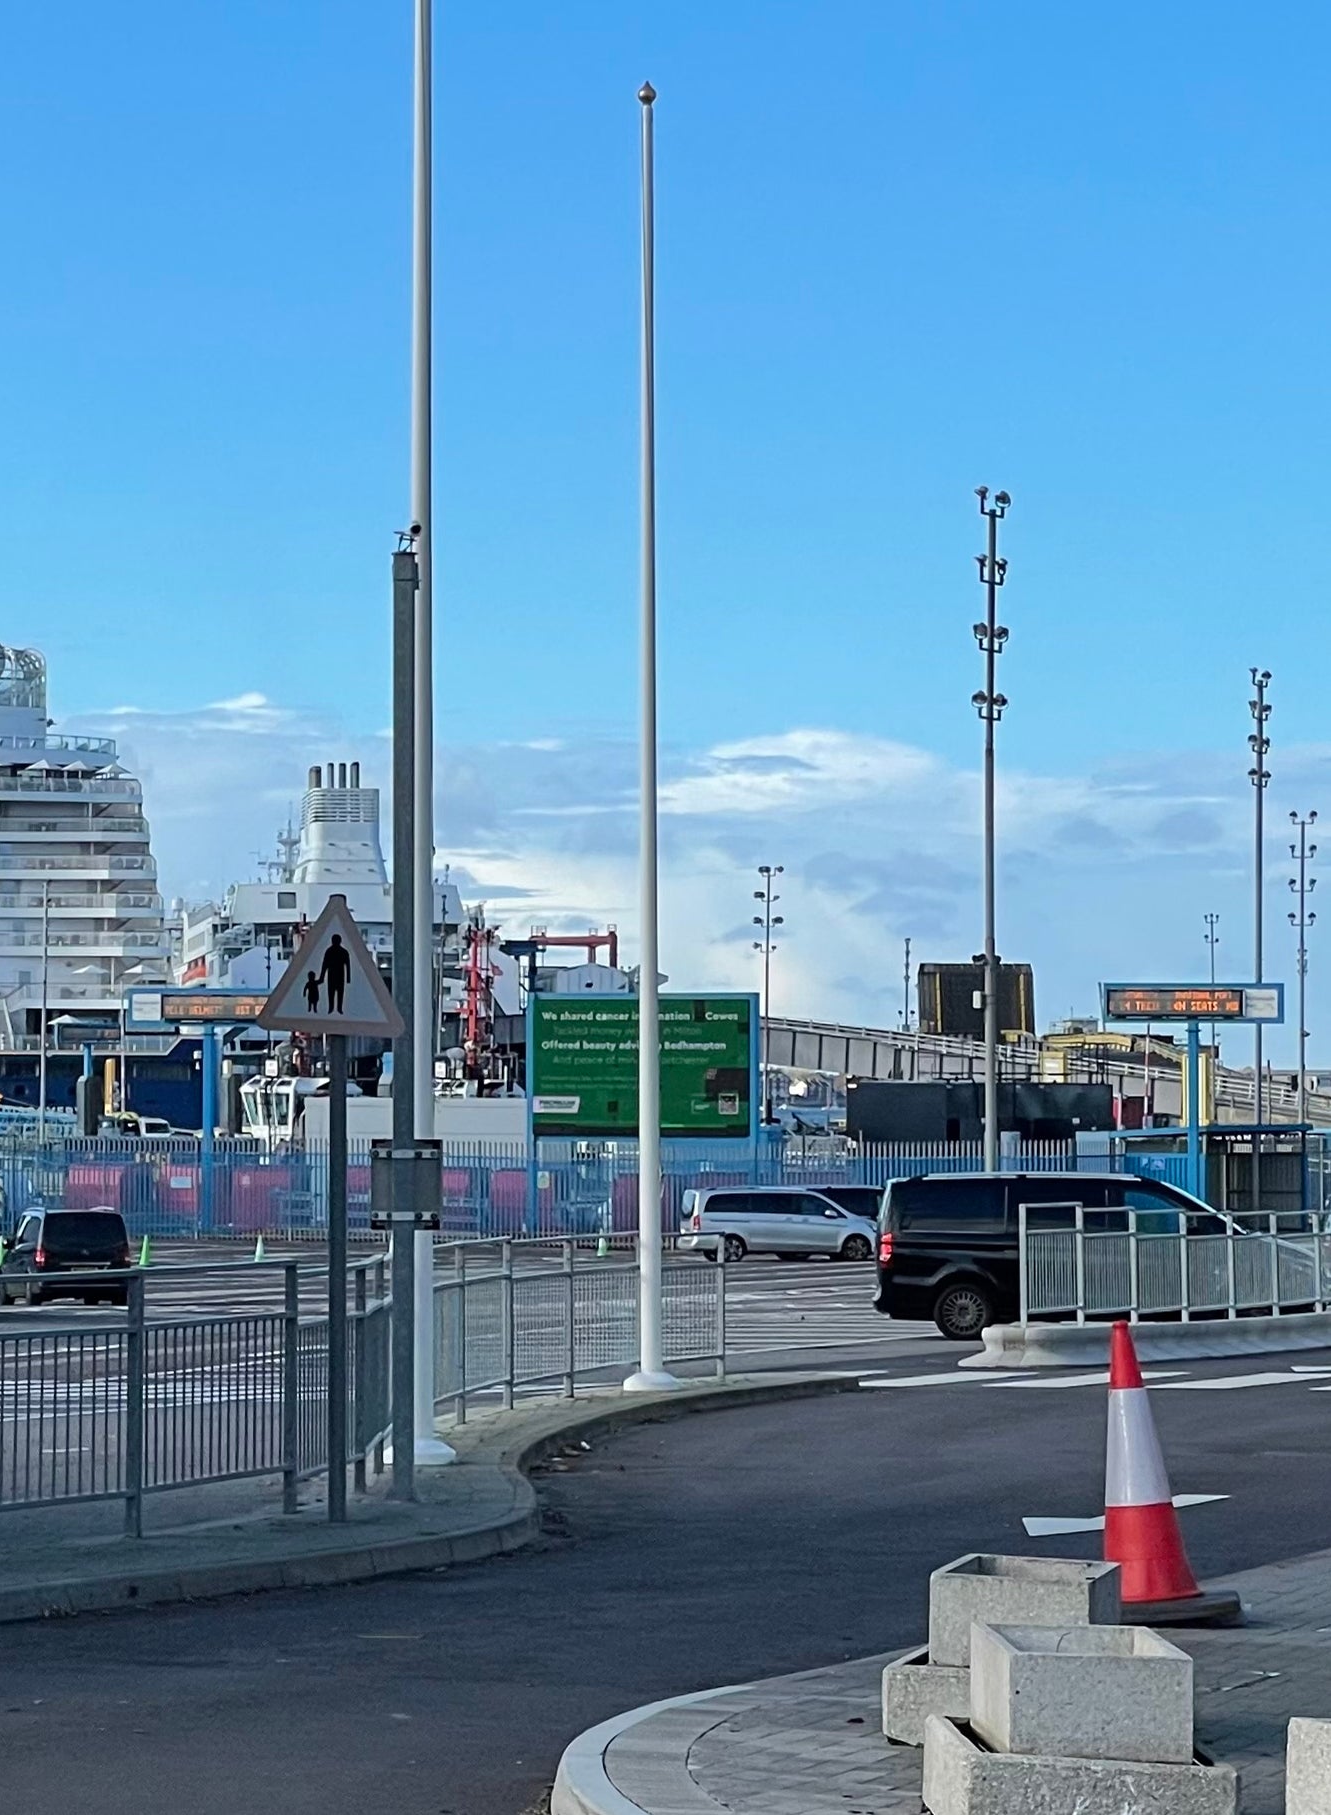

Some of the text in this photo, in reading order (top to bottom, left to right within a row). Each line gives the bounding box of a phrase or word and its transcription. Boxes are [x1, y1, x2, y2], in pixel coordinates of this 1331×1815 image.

[541, 1012, 557, 1021] We
[560, 1011, 593, 1021] shared
[595, 1013, 629, 1021] cancer
[705, 1011, 738, 1021] Cowes
[541, 1040, 580, 1050] Offered
[582, 1040, 616, 1051] beauty
[664, 1040, 726, 1051] Bedhampton
[574, 1057, 602, 1065] peace
